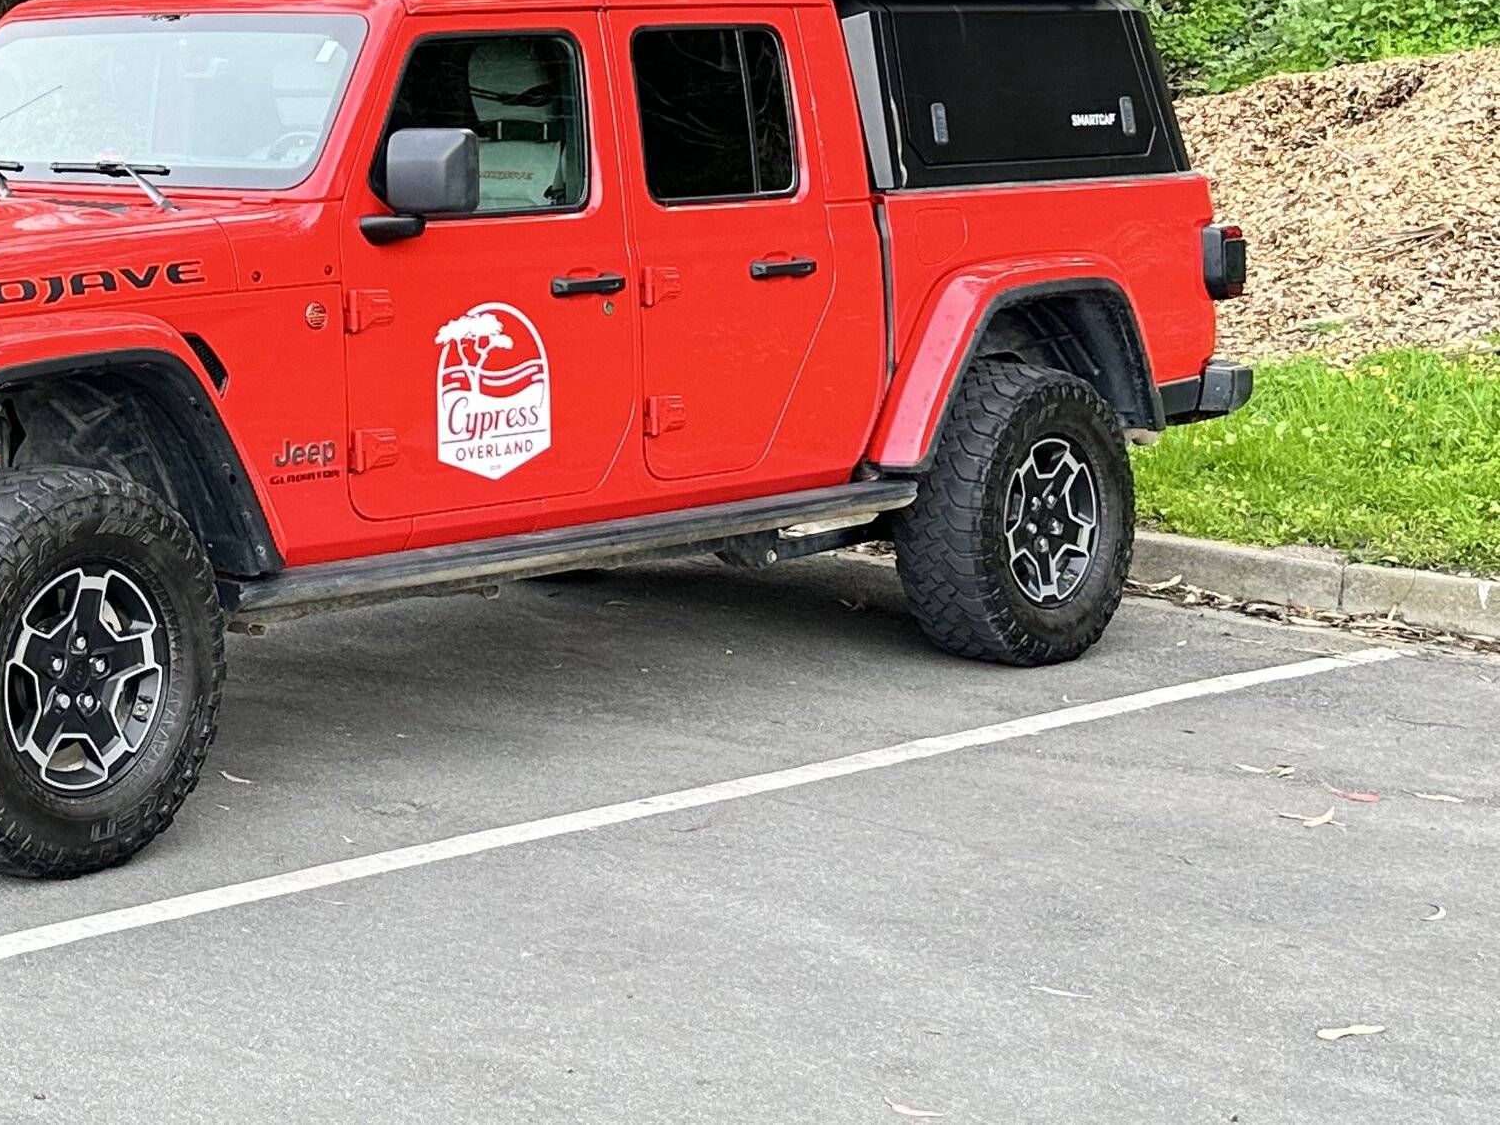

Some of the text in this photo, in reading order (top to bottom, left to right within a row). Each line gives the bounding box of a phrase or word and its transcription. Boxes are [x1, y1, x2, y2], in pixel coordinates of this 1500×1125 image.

[447, 396, 539, 441] Cypress
[273, 439, 336, 467] Jeep
[455, 439, 534, 462] OVERLAND
[269, 469, 341, 486] GLADIATOR
